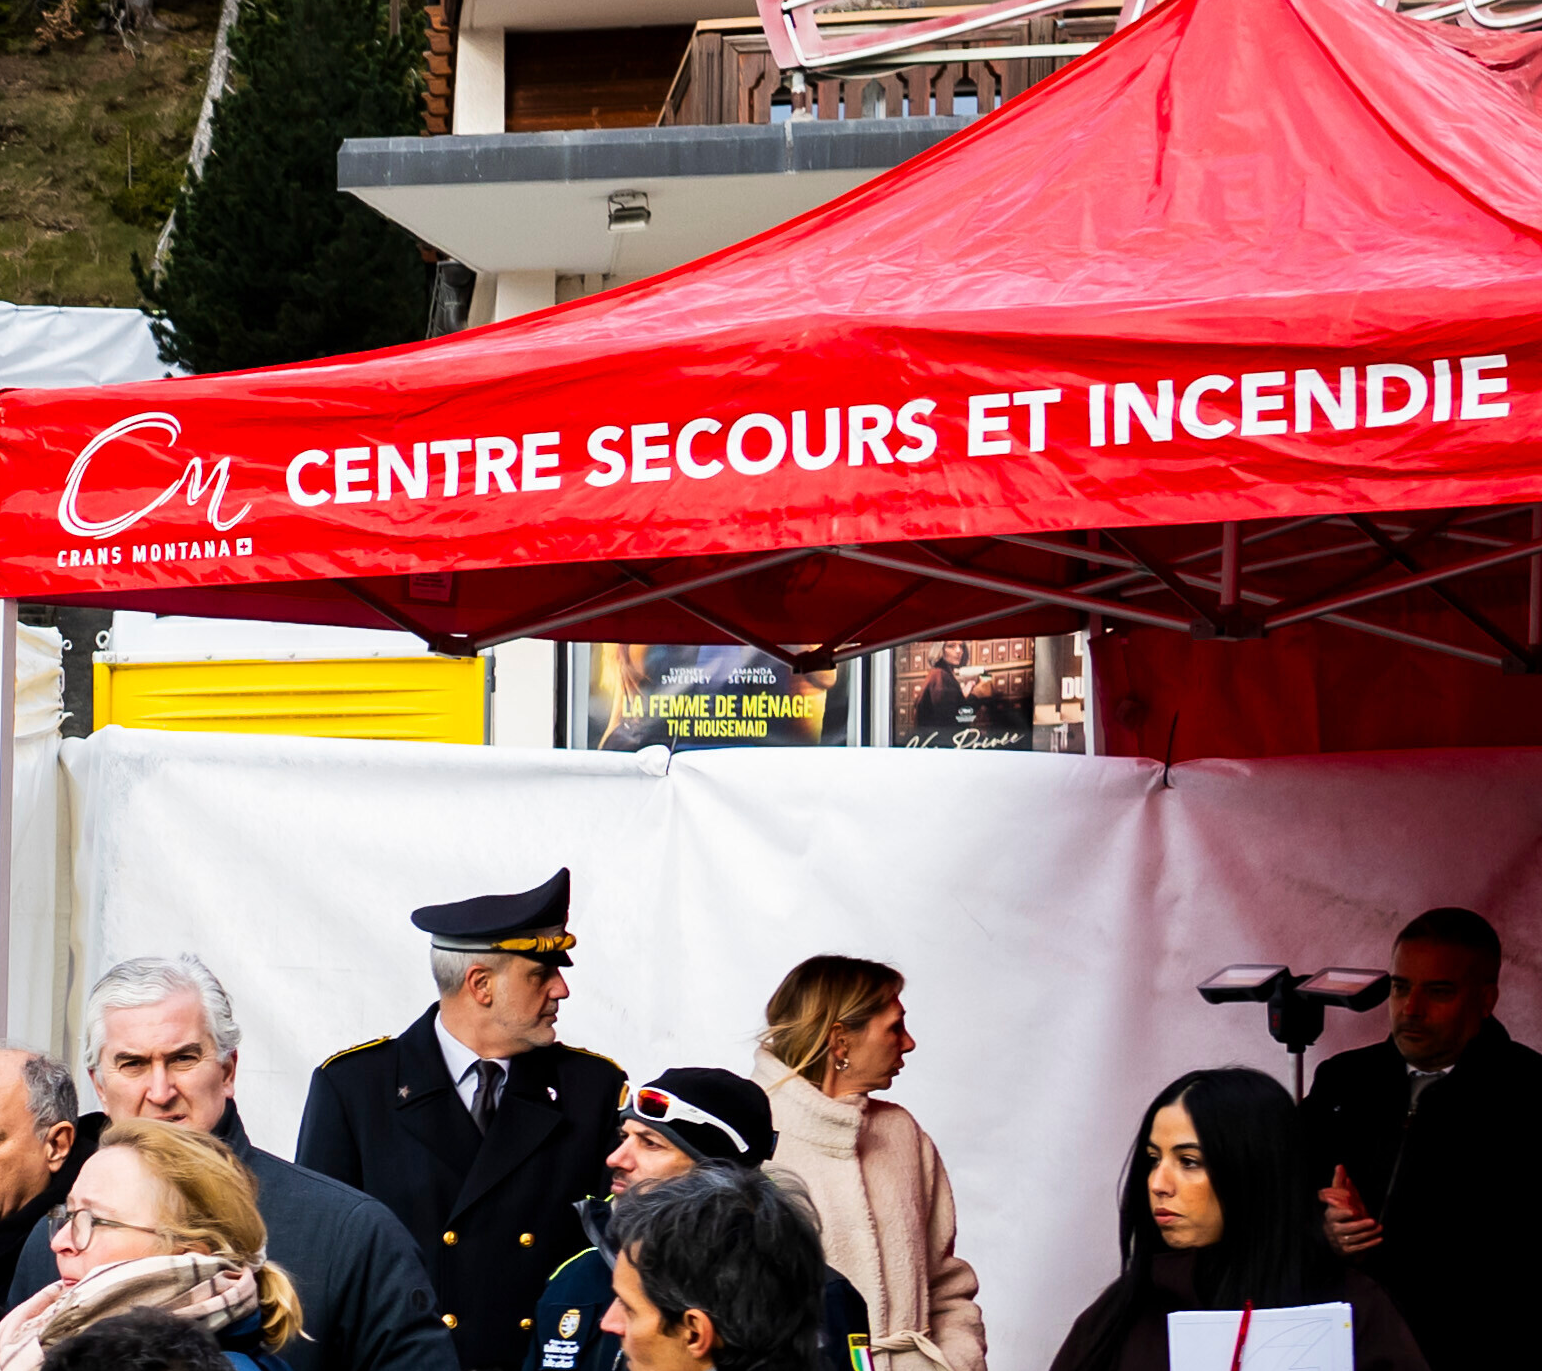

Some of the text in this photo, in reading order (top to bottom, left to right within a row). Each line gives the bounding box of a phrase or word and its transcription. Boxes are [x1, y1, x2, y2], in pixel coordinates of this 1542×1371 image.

[285, 353, 1511, 508] CENTRE SECOURS ET INCENDIE
[56, 539, 231, 568] CRANS MONTANA
[669, 667, 705, 676] SYDNEY
[731, 667, 773, 676] AMANDA
[660, 674, 712, 685] SWEENEY
[727, 674, 777, 685] SEYFRIED
[622, 691, 814, 719] LA FEMME DE MÉNAGE
[666, 719, 768, 738] THE HOUSEMAID
